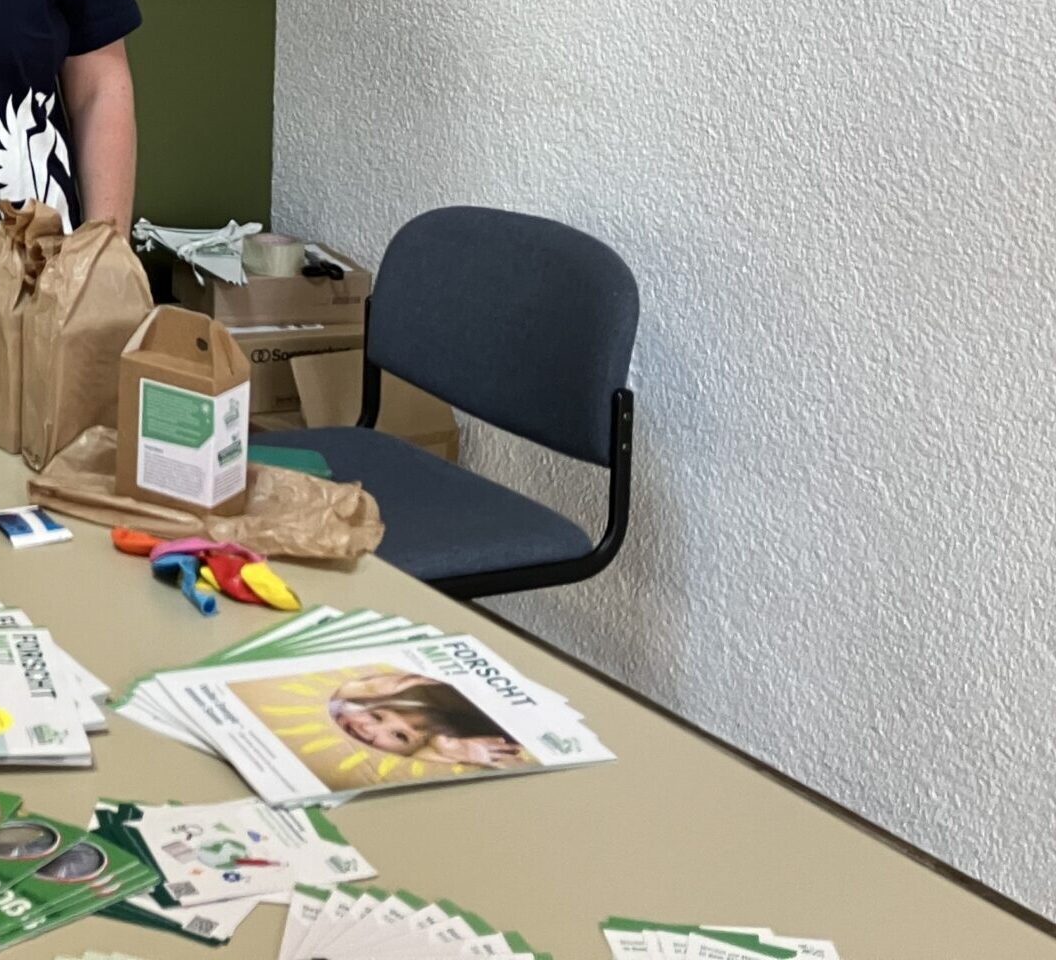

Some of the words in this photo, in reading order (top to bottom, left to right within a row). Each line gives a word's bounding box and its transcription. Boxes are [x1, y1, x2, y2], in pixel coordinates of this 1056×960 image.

[13, 634, 57, 698] FORSCHT
[417, 646, 469, 676] MIT!
[443, 641, 537, 706] FORSCHT
